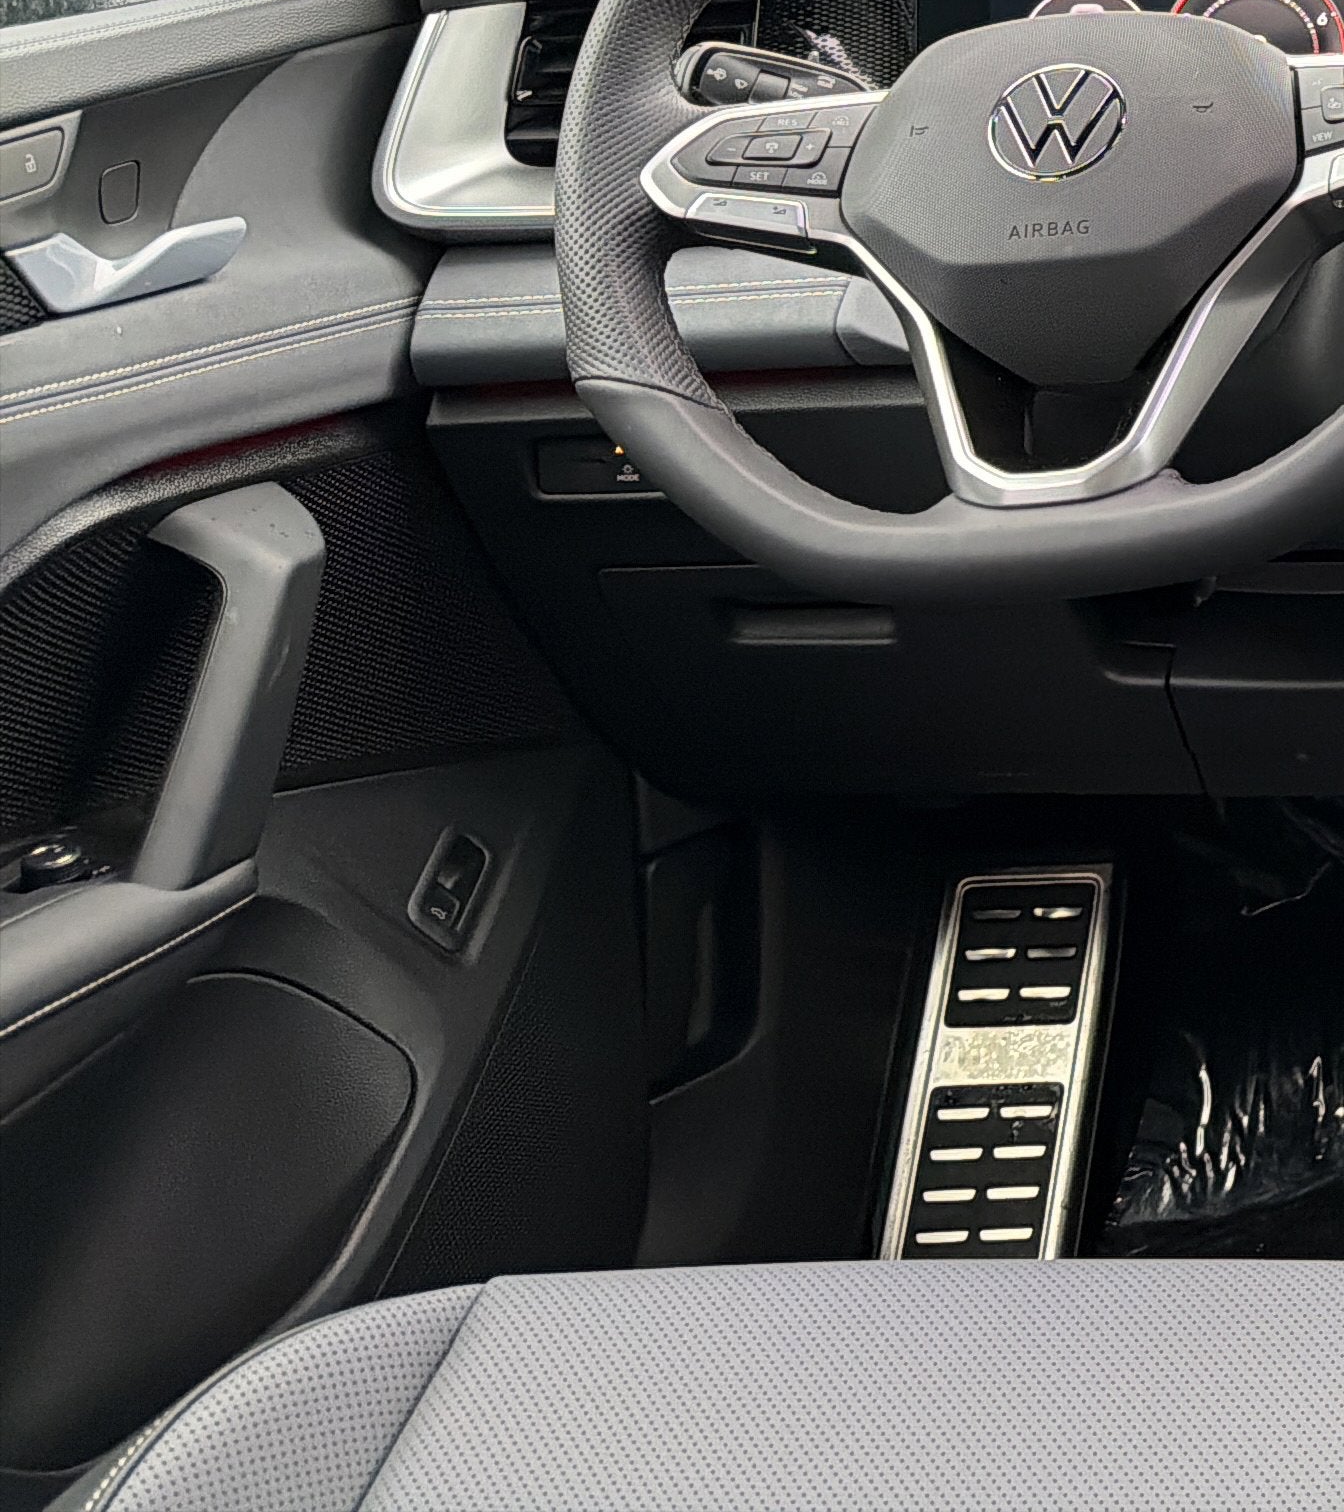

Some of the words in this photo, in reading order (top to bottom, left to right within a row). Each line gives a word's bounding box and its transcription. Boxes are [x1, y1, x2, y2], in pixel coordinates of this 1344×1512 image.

[1317, 12, 1328, 26] 6
[1312, 132, 1332, 143] VIEW
[750, 172, 769, 180] SET
[1009, 220, 1090, 240] AIRBAG
[616, 474, 640, 482] MODE
